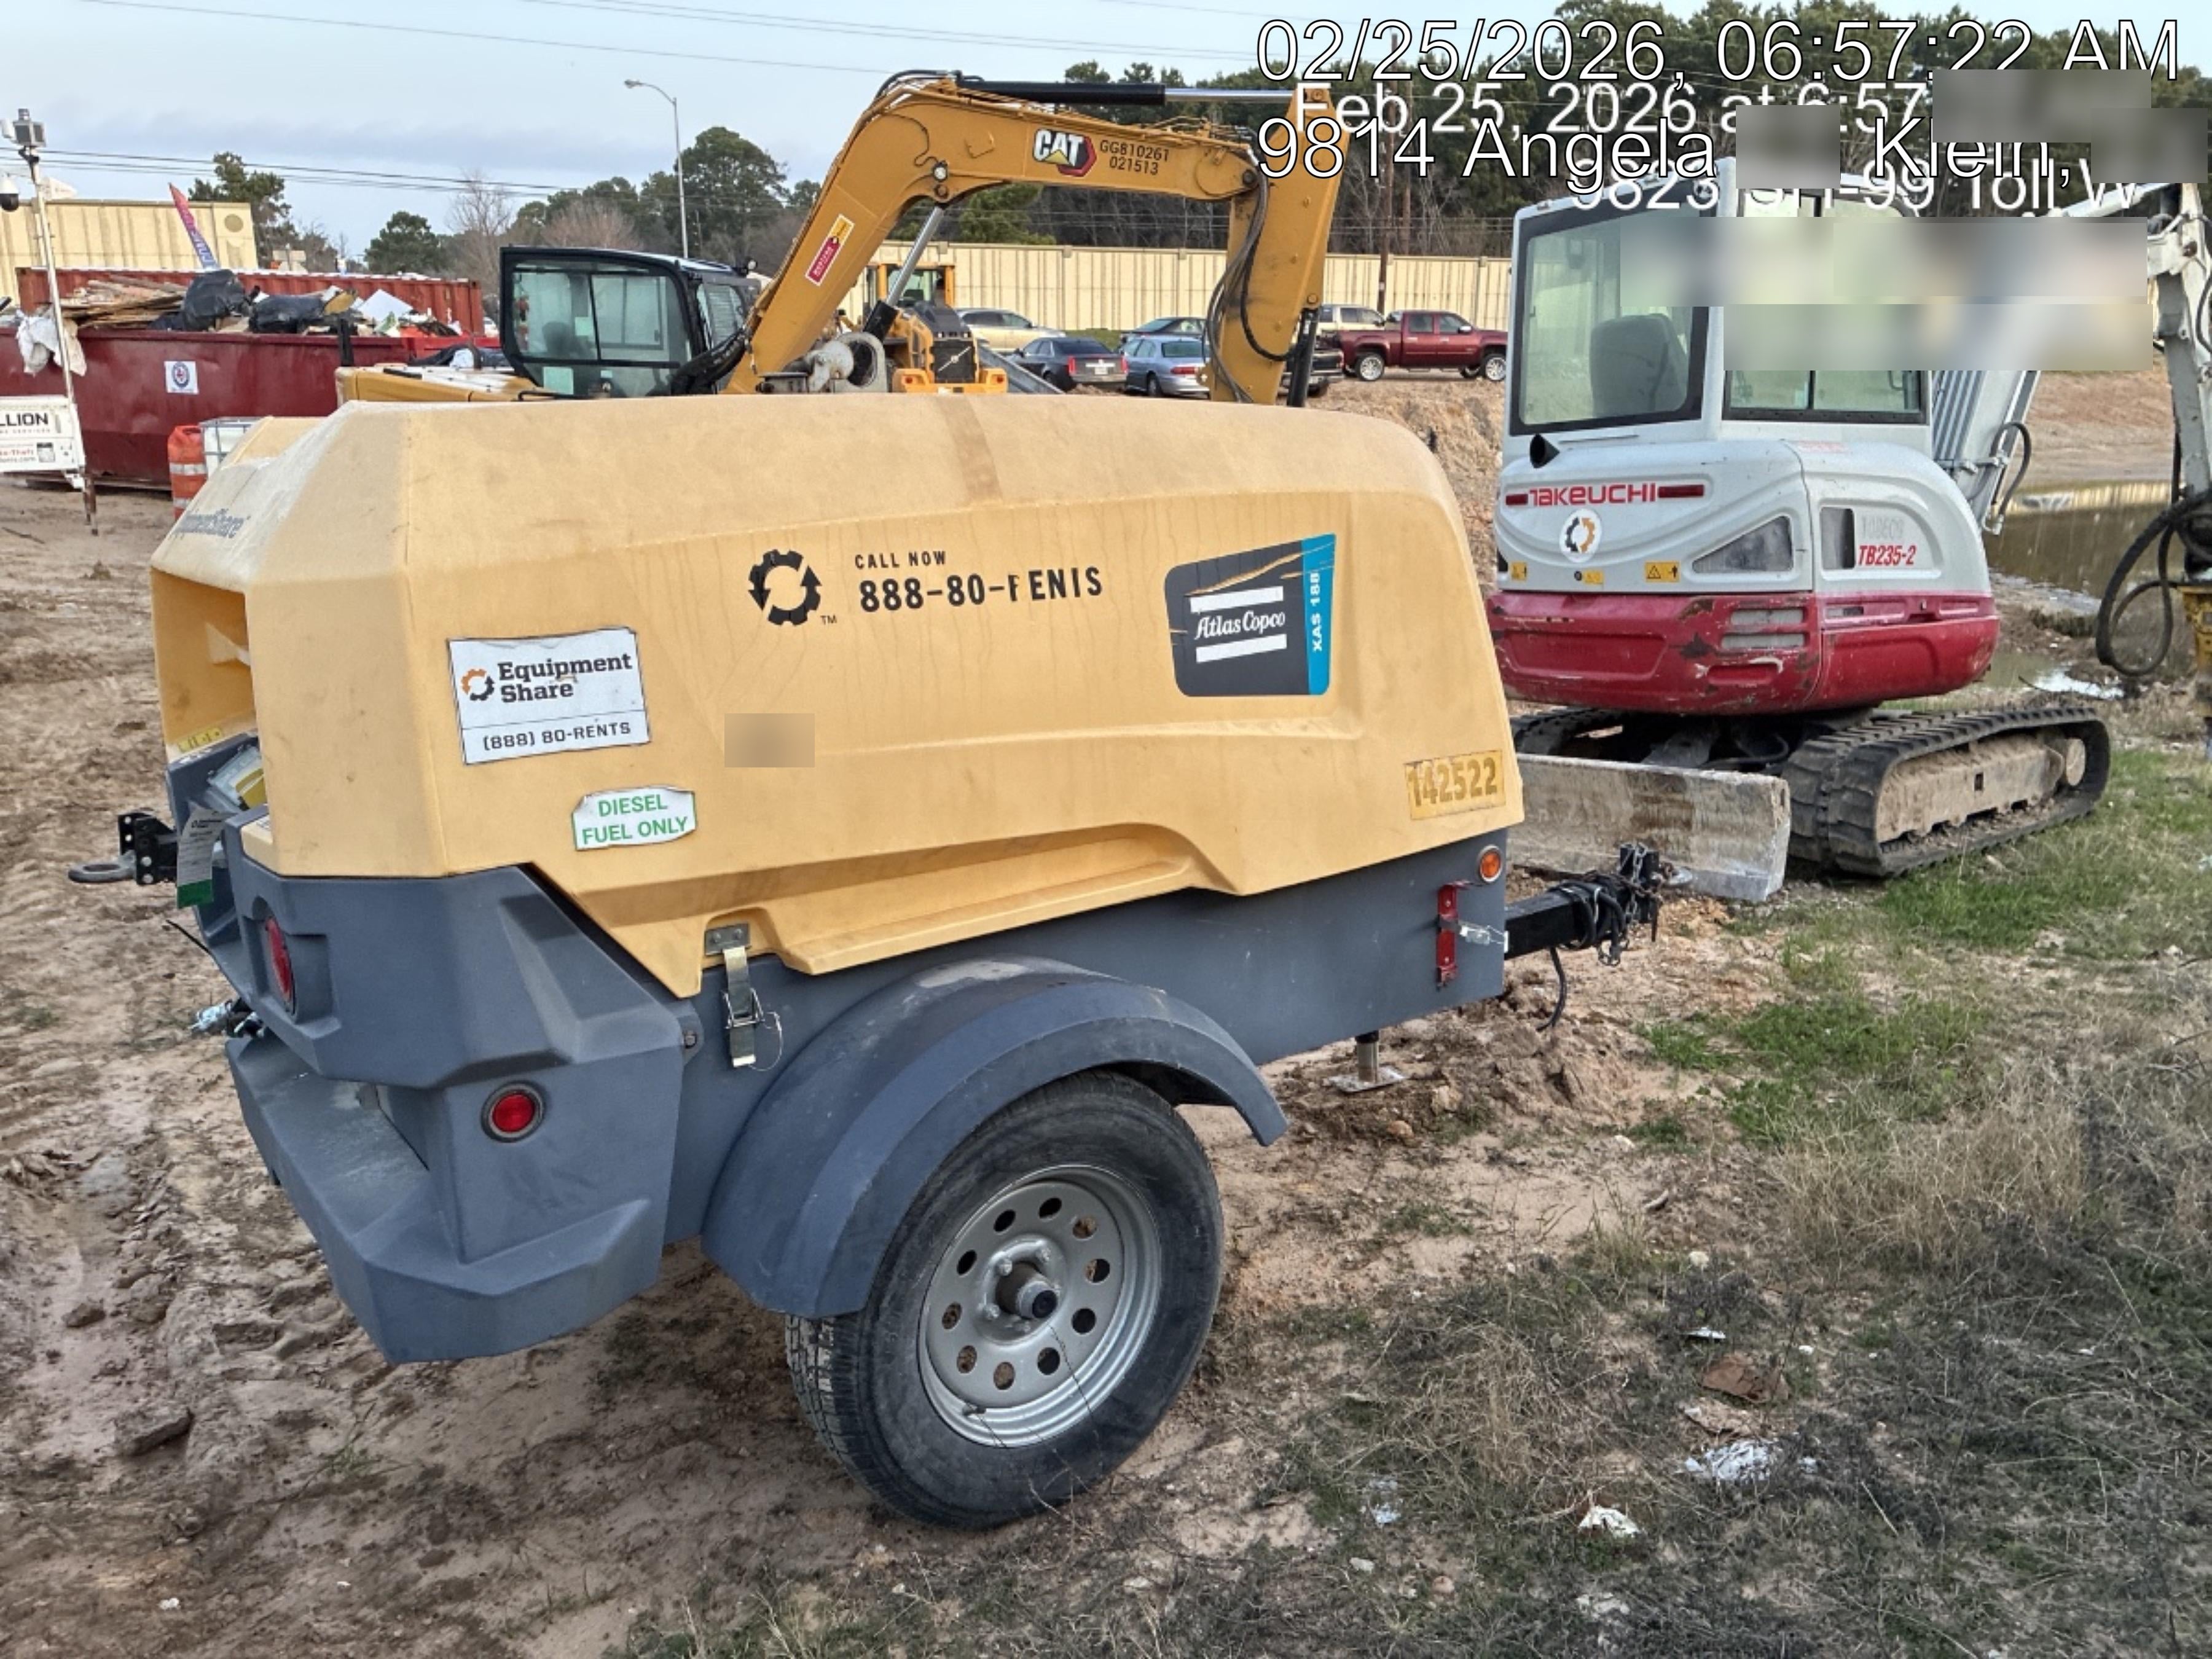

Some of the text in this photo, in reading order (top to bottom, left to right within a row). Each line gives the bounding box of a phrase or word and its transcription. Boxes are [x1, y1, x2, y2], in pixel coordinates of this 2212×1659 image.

[1033, 128, 1084, 167] CAT
[1109, 155, 1159, 176] 021513
[855, 551, 947, 569] CALL NOW
[1858, 544, 1917, 566] TB235-2
[1194, 610, 1286, 640] Atlas Copco
[1311, 613, 1322, 652] XAS
[498, 653, 632, 683] Equipment
[501, 682, 574, 703] Share
[483, 721, 631, 751] (888) 80-RENTS
[1408, 756, 1497, 807] 142522
[598, 794, 669, 817] DIESEL
[582, 816, 688, 845] FUEL ONLY
